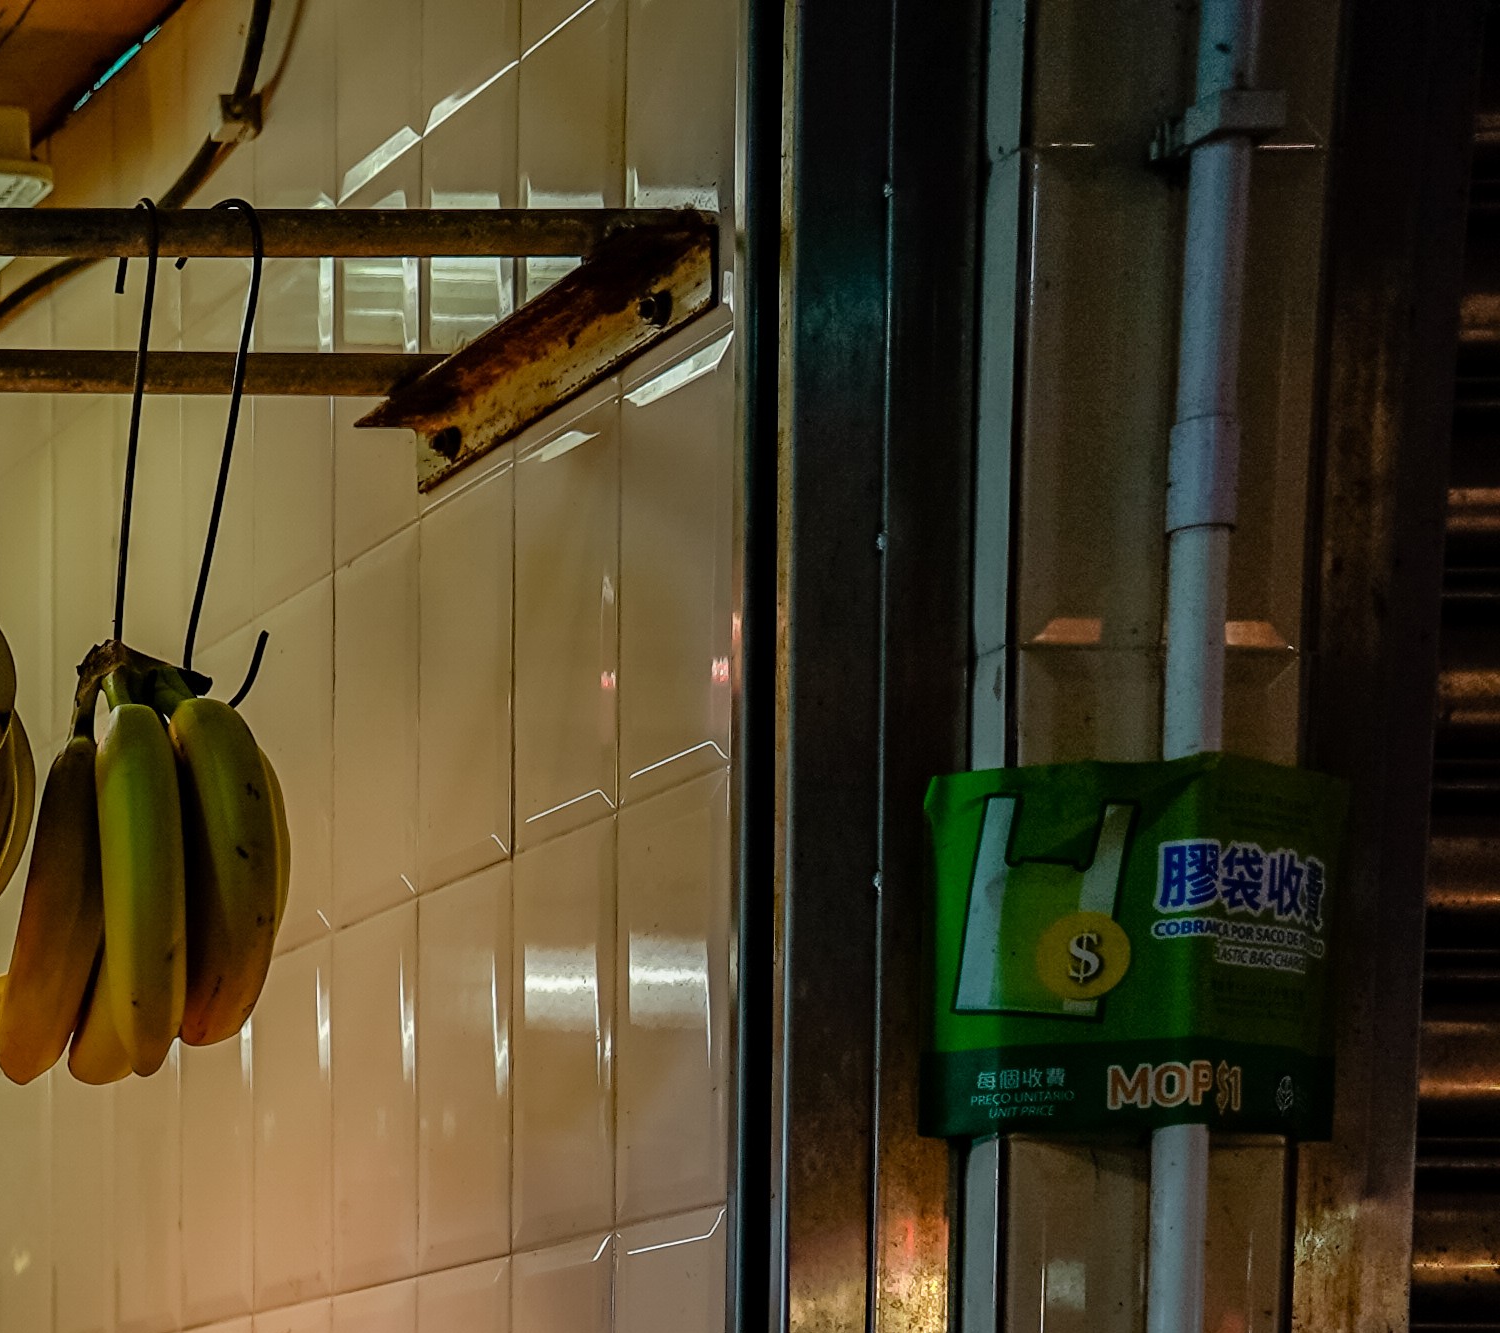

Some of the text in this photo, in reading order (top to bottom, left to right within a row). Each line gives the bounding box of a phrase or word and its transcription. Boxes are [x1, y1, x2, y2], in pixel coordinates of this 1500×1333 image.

[1157, 842, 1325, 932] 膠袋收費
[1256, 928, 1284, 944] SACO
[1250, 951, 1272, 967] BAG
[976, 1067, 1066, 1091] 每個收費
[1106, 1060, 1213, 1111] MOP
[988, 1104, 1055, 1120] UNIT PRICE
